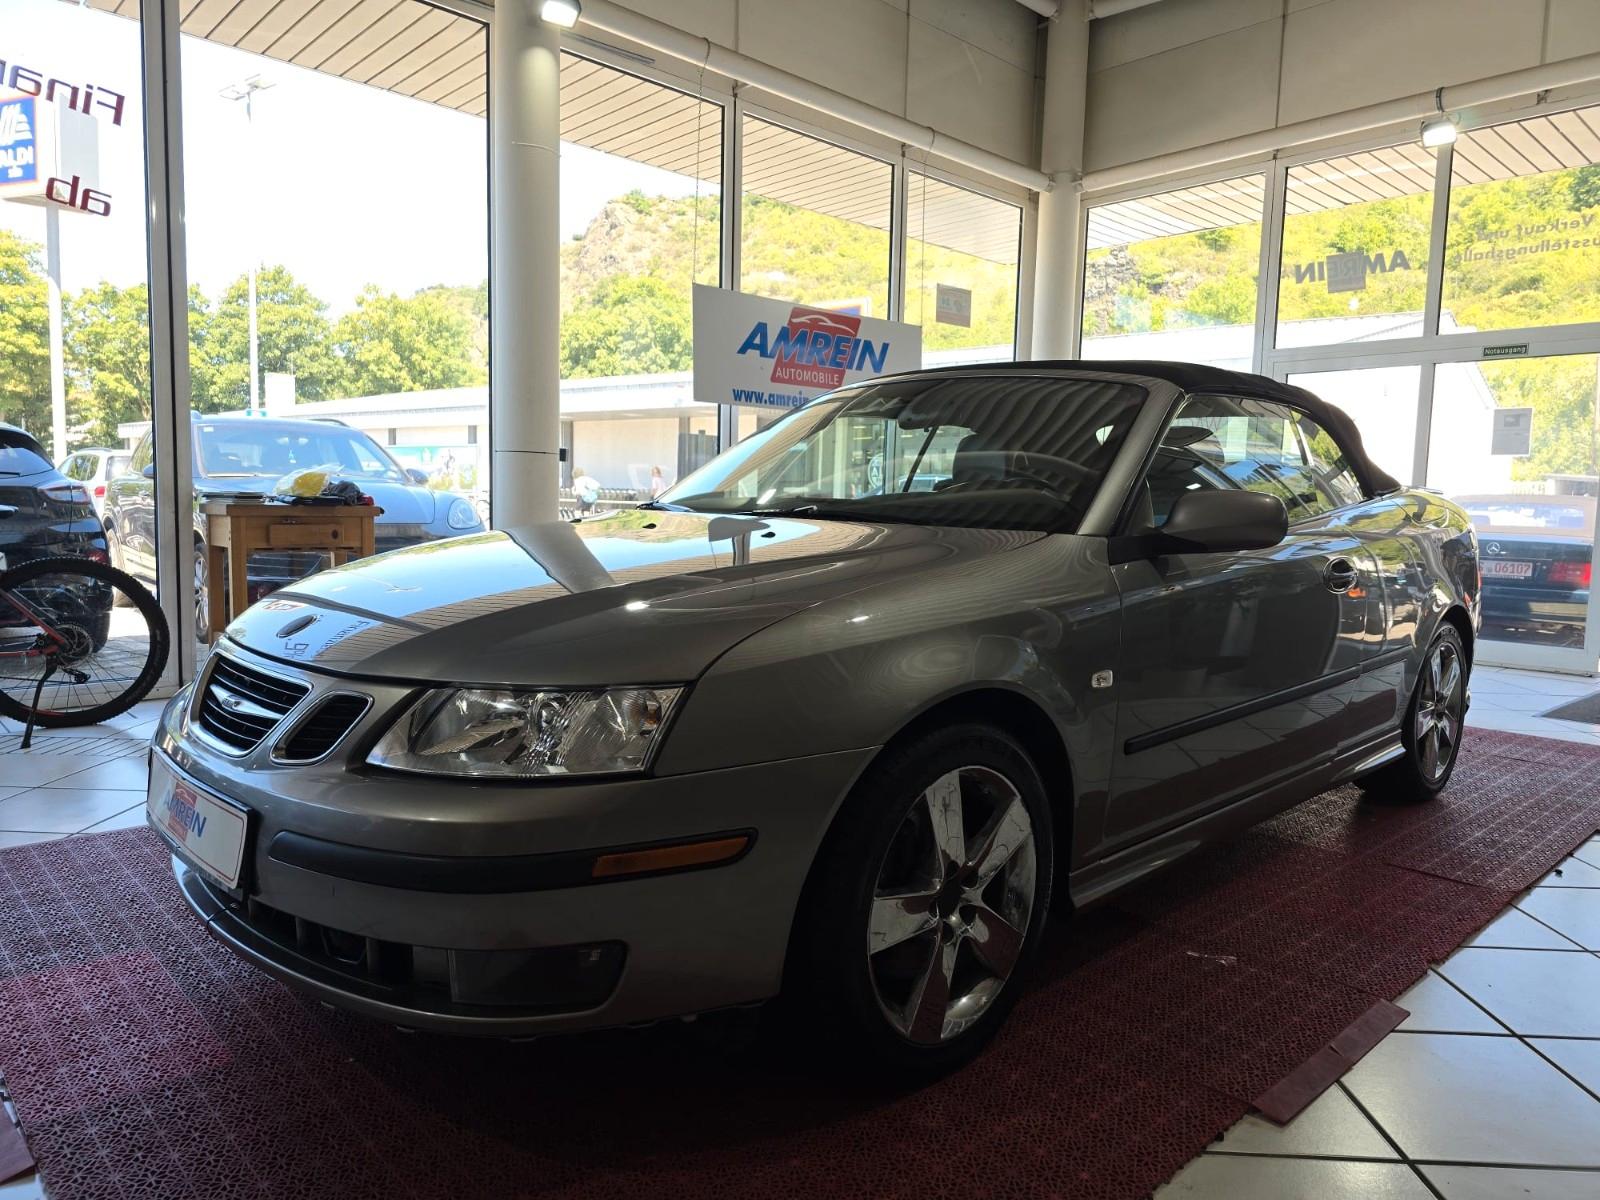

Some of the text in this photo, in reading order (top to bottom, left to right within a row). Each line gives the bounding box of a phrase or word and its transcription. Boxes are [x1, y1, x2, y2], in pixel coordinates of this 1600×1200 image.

[736, 321, 890, 374] AMREIN
[775, 367, 840, 386] AUTOMOBILE
[163, 788, 207, 838] AMREIN
